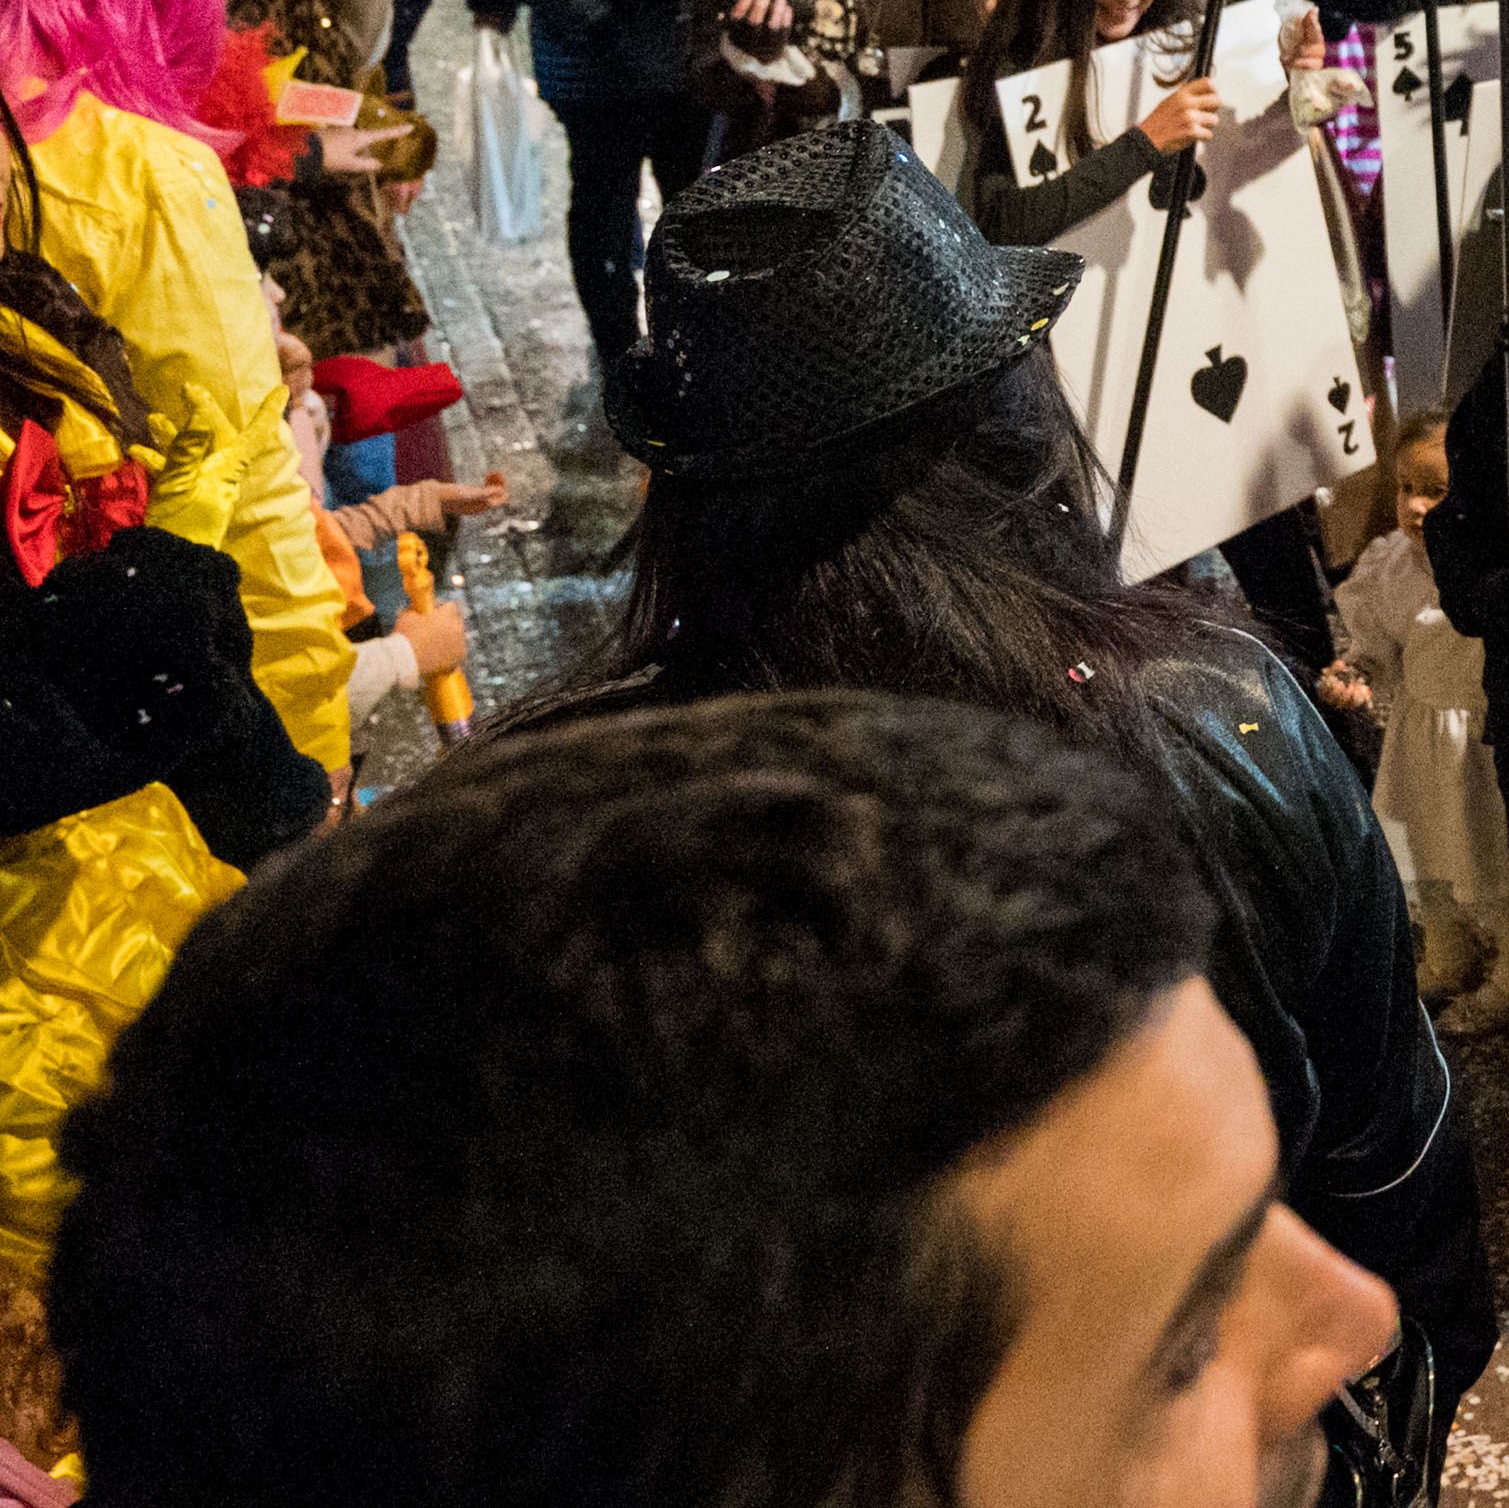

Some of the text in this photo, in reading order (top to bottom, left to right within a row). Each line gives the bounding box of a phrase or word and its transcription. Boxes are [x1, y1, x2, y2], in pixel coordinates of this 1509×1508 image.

[1393, 32, 1414, 60] 5
[1021, 94, 1047, 133] 2
[1339, 421, 1360, 456] 2
